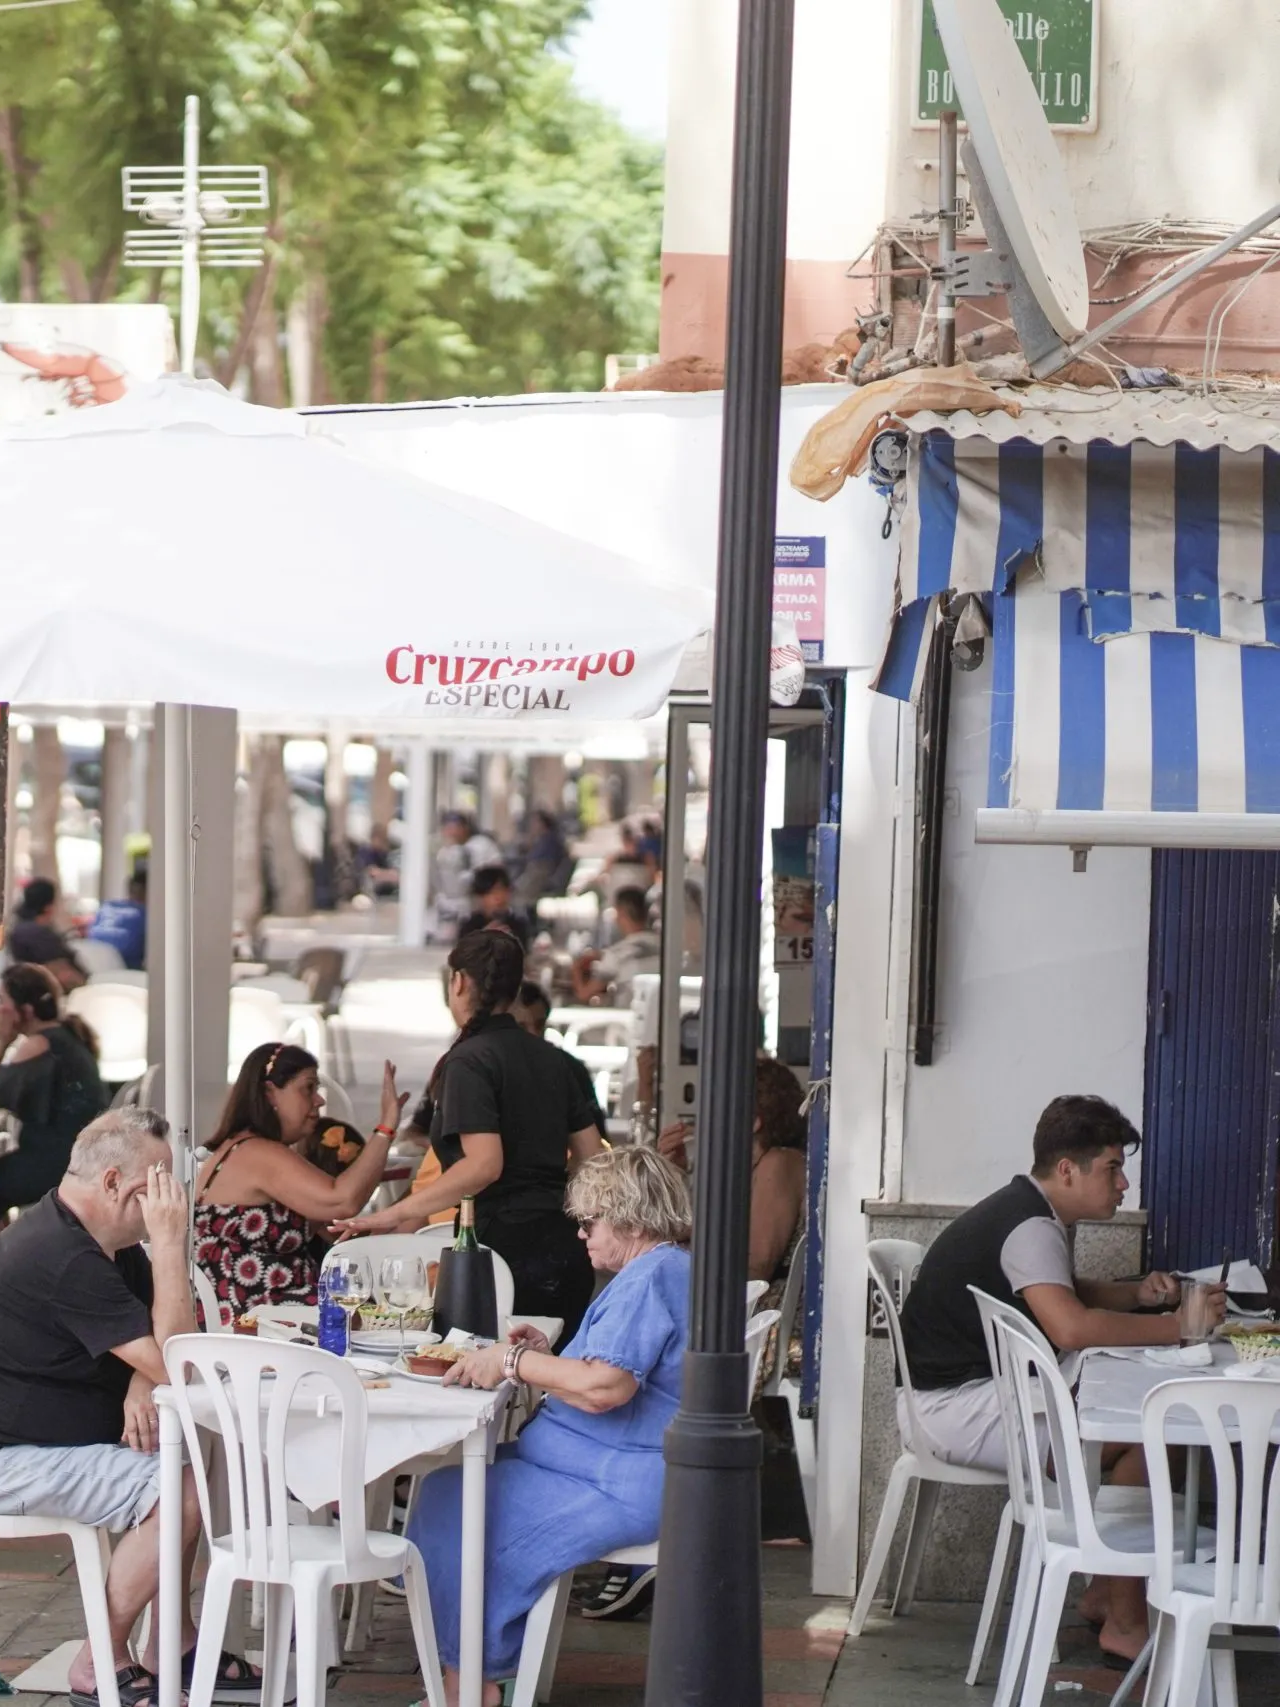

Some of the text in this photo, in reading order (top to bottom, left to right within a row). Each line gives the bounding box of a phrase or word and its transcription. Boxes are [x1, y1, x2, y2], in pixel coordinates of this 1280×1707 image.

[453, 640, 574, 651] DESDE 1904
[385, 644, 635, 686] Cruzcampo
[425, 683, 570, 711] ESPECIAL
[787, 937, 814, 960] 15
